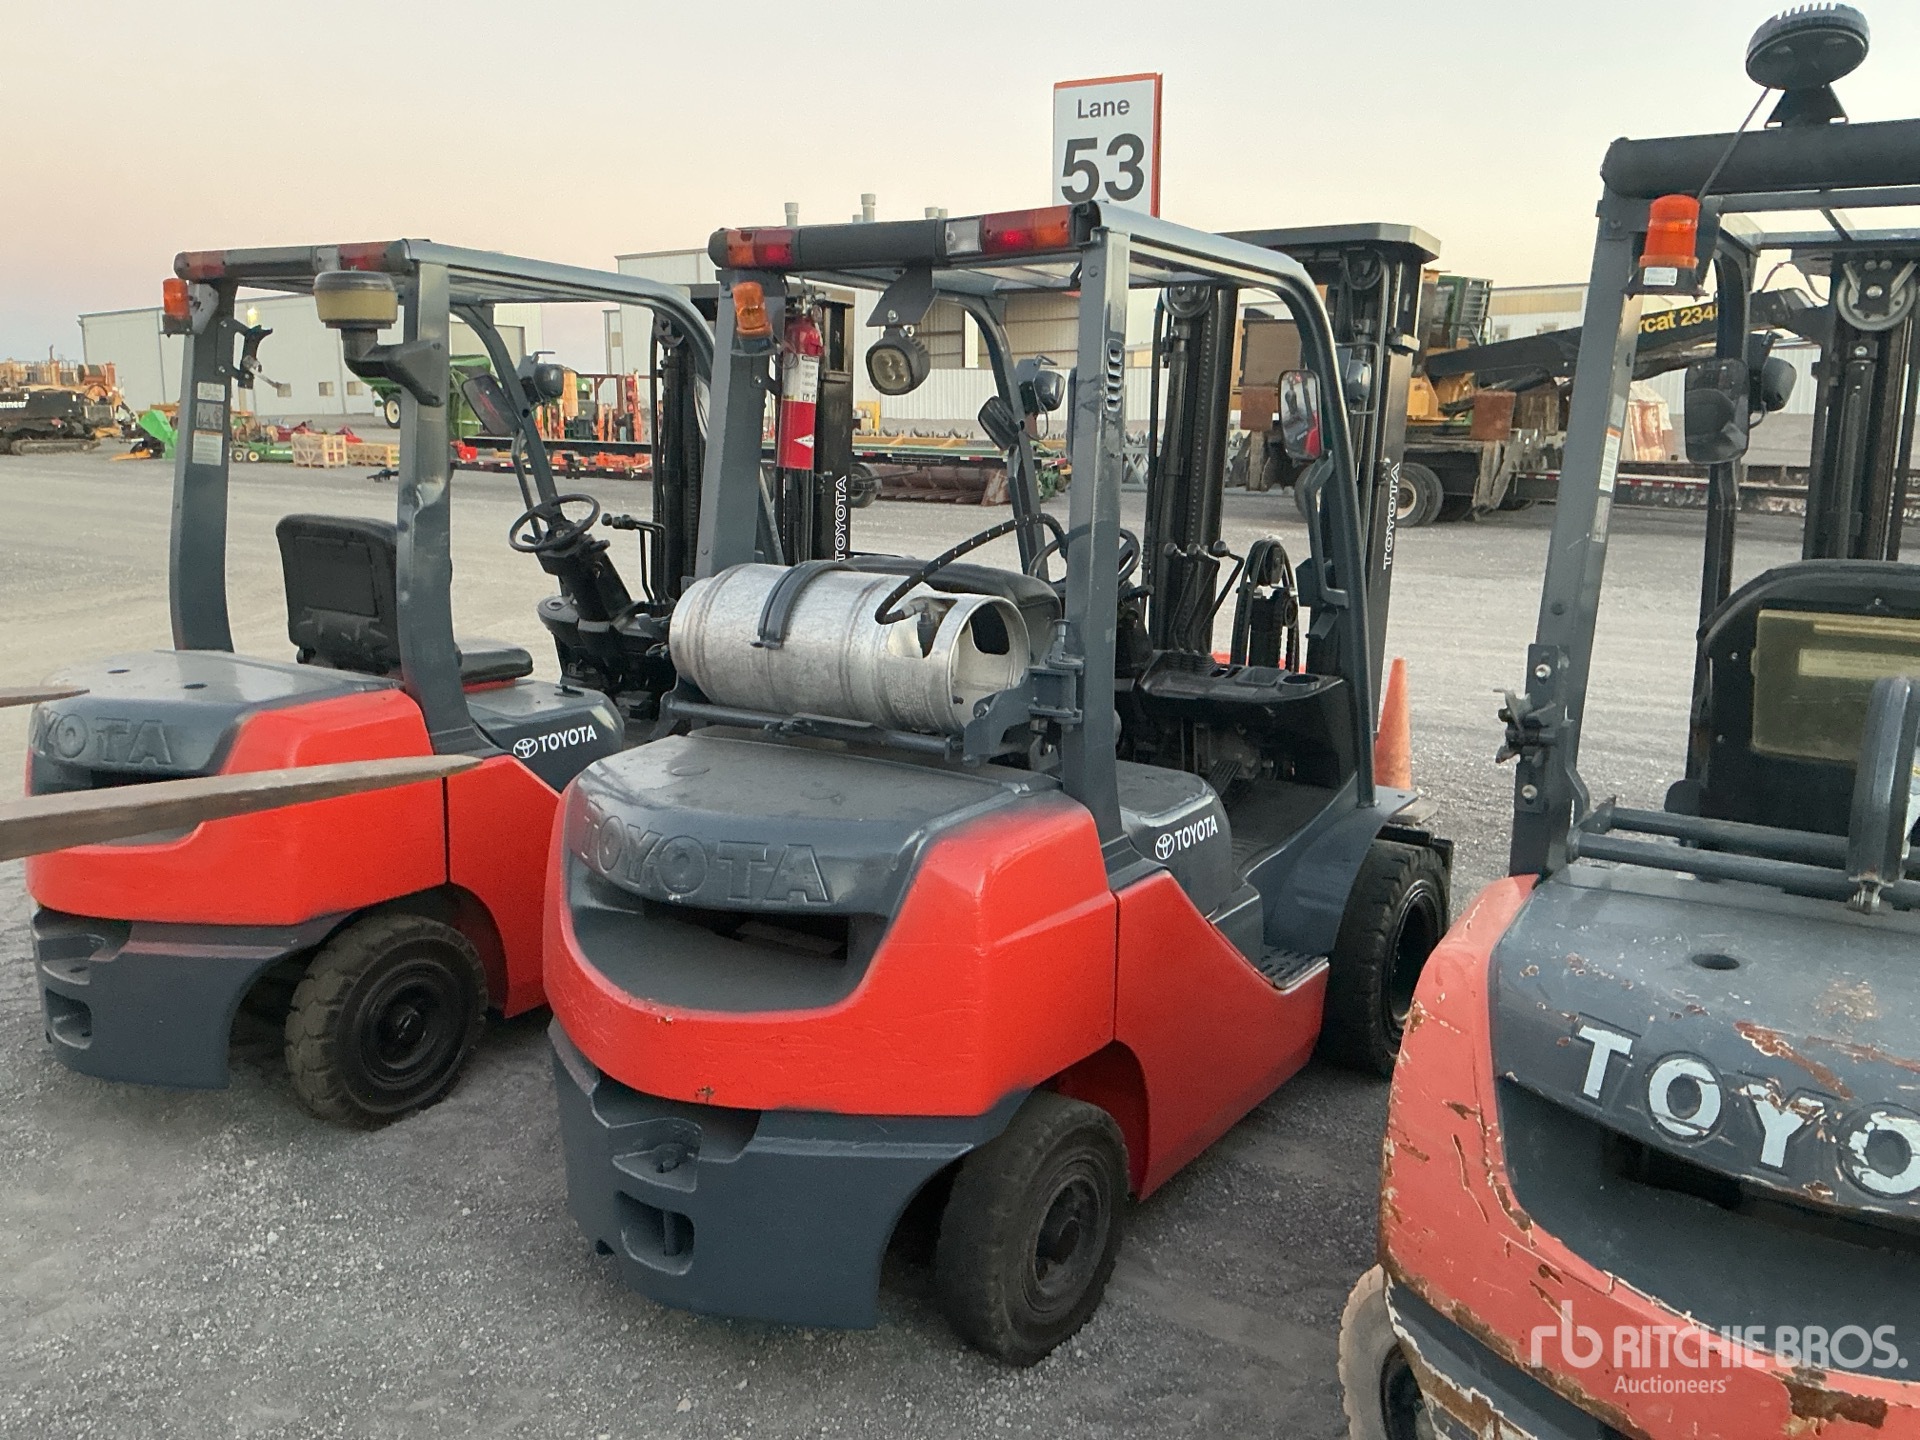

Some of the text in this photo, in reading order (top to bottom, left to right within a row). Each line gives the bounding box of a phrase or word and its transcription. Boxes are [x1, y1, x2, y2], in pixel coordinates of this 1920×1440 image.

[1077, 99, 1130, 119] Lane
[1061, 133, 1145, 204] 53
[1680, 305, 1718, 327] 234
[1383, 462, 1400, 570] TOYOTA
[538, 724, 598, 753] TOYOTA
[581, 800, 831, 903] TOYOTA
[1174, 814, 1219, 851] TOYOTA
[1577, 1023, 1920, 1196] TOYO
